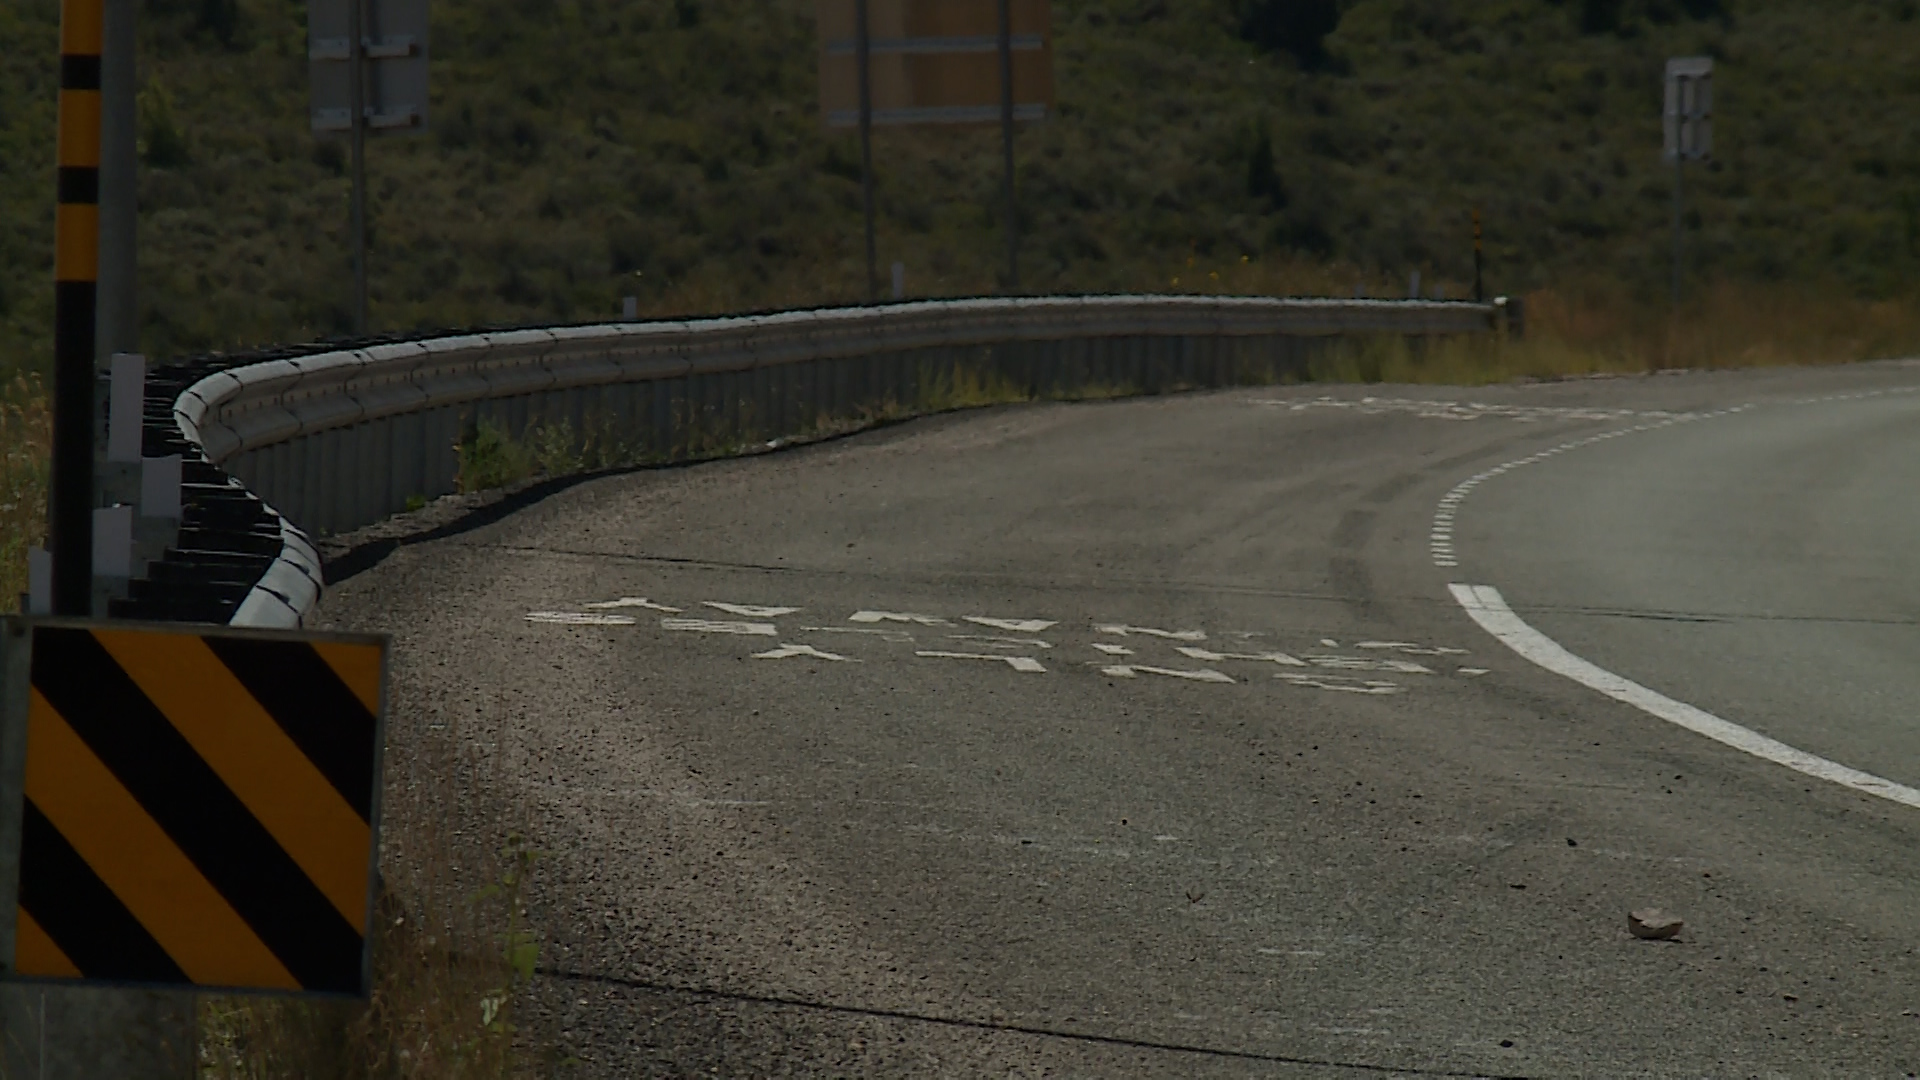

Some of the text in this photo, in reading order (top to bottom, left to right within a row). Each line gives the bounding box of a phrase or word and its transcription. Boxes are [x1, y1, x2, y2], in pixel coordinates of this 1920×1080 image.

[524, 611, 1490, 675] EHICLES
[585, 597, 1471, 656] NAWAY
[750, 643, 1397, 694] ONLY
